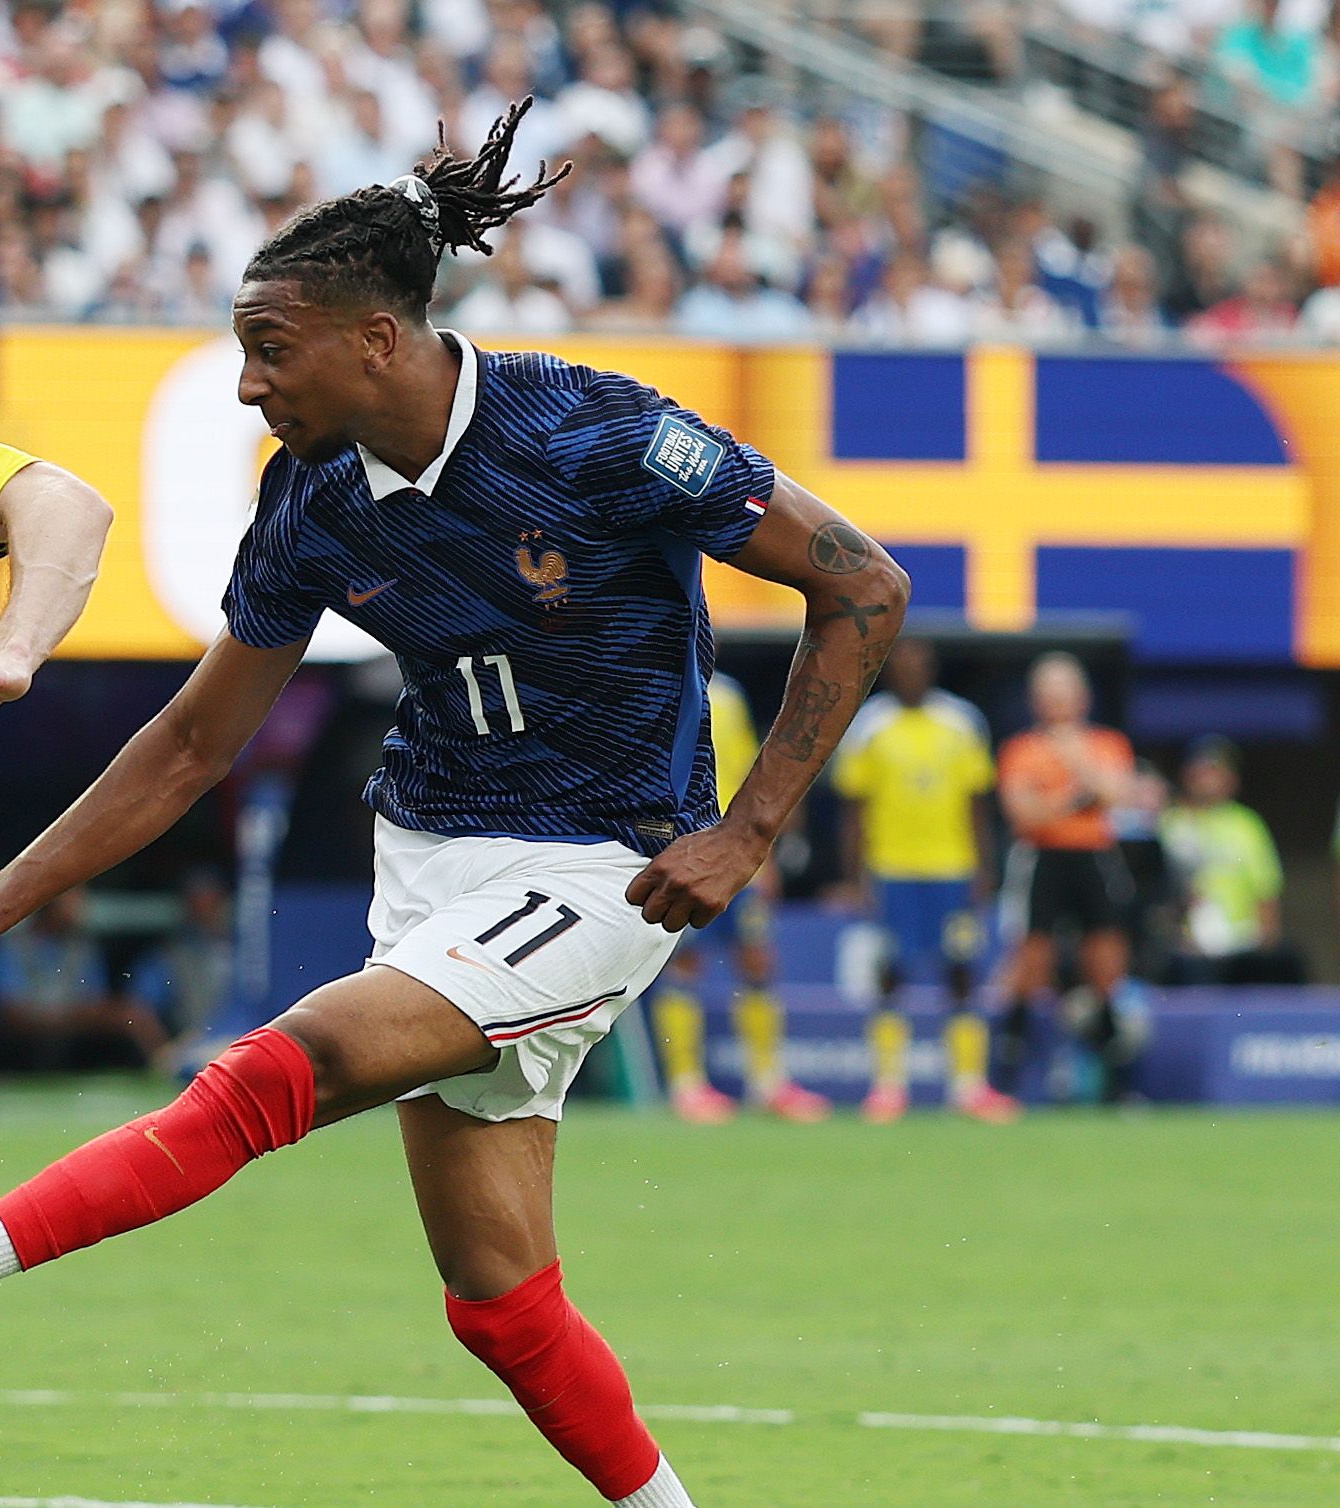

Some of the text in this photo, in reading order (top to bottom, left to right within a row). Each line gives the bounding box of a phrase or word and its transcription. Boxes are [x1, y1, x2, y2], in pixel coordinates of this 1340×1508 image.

[655, 427, 680, 465] FOOTBALL
[665, 432, 693, 473] UNITES
[678, 437, 707, 482] the World
[696, 460, 708, 476] FIFA
[456, 654, 525, 735] 11
[474, 890, 582, 968] 11
